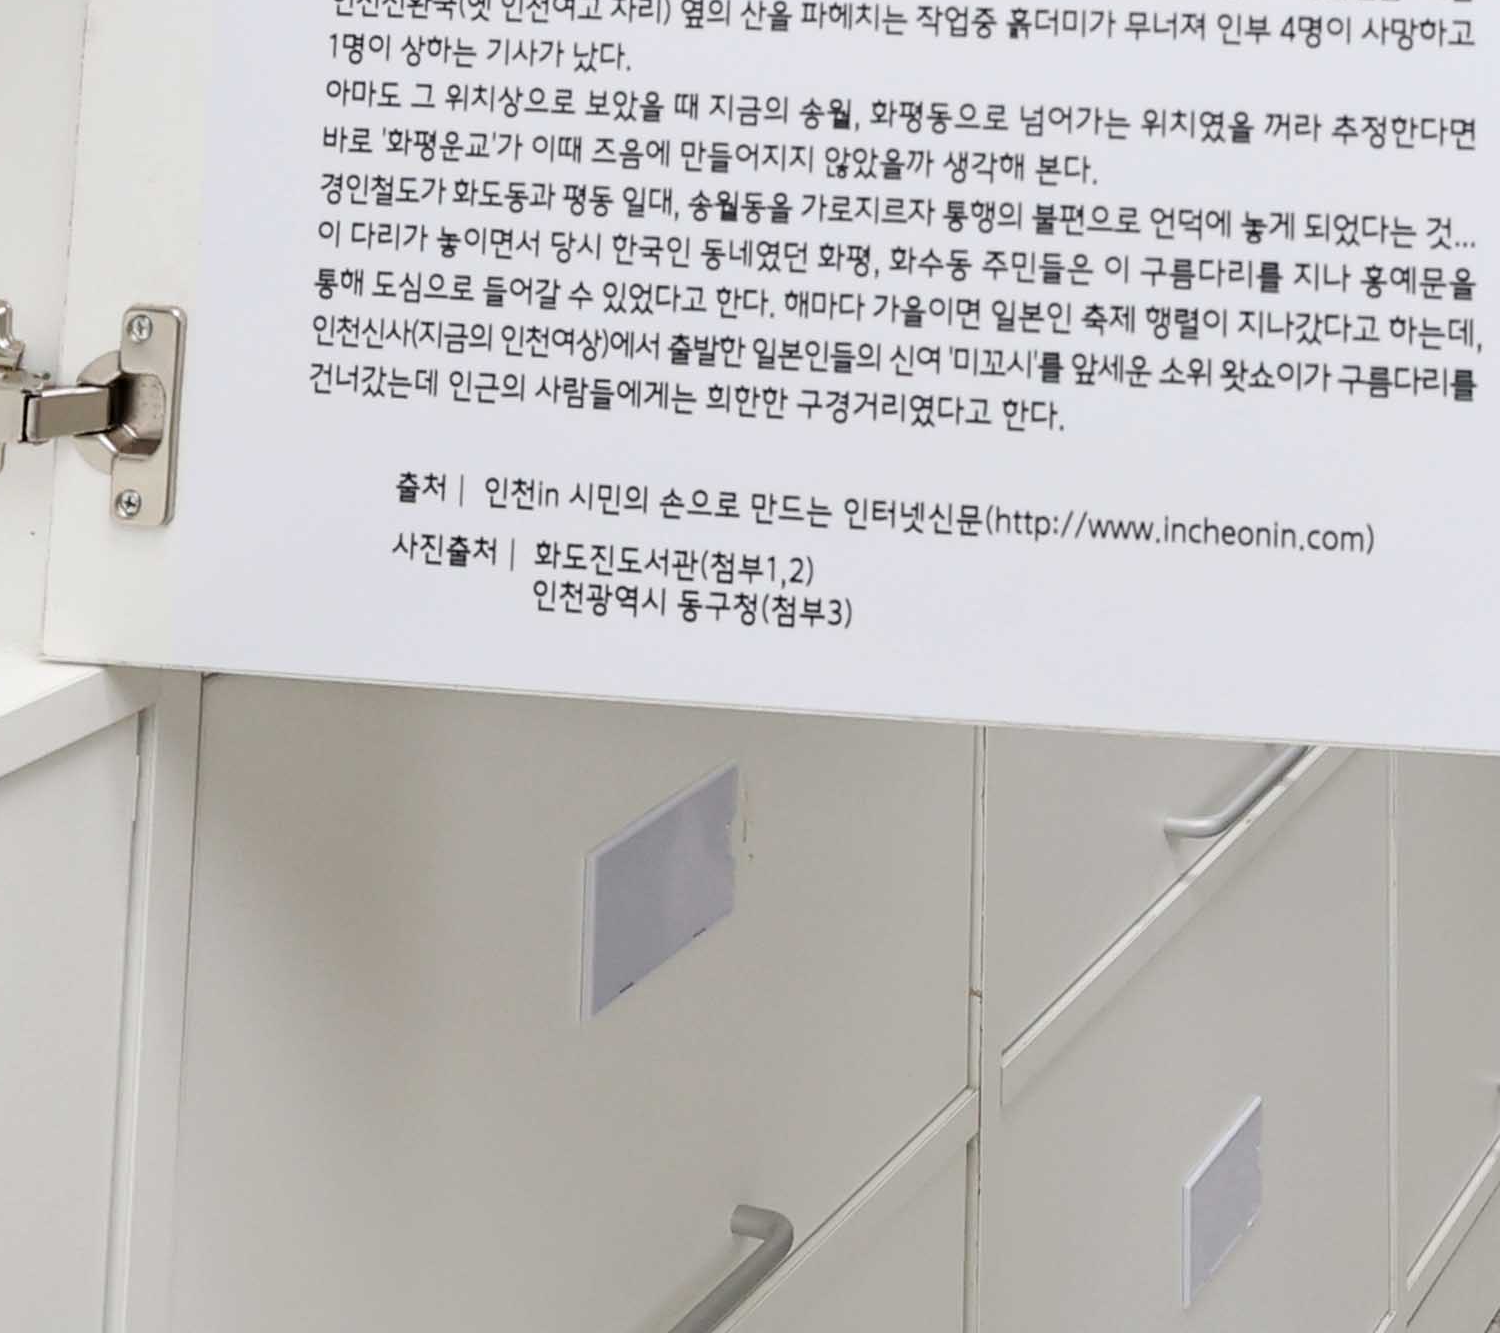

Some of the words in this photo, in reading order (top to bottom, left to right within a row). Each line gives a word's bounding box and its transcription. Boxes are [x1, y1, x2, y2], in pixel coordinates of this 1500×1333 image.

[329, 32, 391, 66] 1명이
[400, 34, 477, 69] 상하는
[486, 38, 565, 68] 기사가
[573, 41, 631, 73] 났다.
[325, 78, 402, 108] 아마도
[410, 83, 436, 109] 그
[444, 83, 577, 118] 위치상으로
[584, 89, 665, 123] 보았을
[674, 92, 699, 121] 때
[708, 94, 789, 127] 지금의
[798, 97, 860, 132] 송월,
[869, 98, 1009, 136] 화평동으로
[1019, 105, 1132, 141] 넘어가는
[1141, 108, 1255, 144] 위치였을
[1264, 112, 1322, 142] 꺼라
[1331, 114, 1476, 151] 추정한다면
[309, 362, 439, 400] 건너갔는데
[449, 370, 525, 405] 인근의
[534, 375, 697, 416] 사람들에게는
[705, 383, 789, 420] 희한한
[796, 389, 992, 428] 구경거리였다고
[1002, 398, 1065, 432] 한다.
[395, 471, 447, 505] 출처
[484, 476, 560, 511] 인천in
[568, 482, 649, 517] 시민의
[659, 487, 741, 520] 손으로
[750, 493, 833, 529] 만드는
[844, 497, 1375, 555] 인터넷신문(http://www.incheonin.com)
[391, 532, 497, 568] 사진출처
[533, 540, 814, 590] 화도진도서관(첨부1,2)
[533, 579, 667, 618] 인천광역시
[676, 588, 853, 629] 동구청(첨부3)
